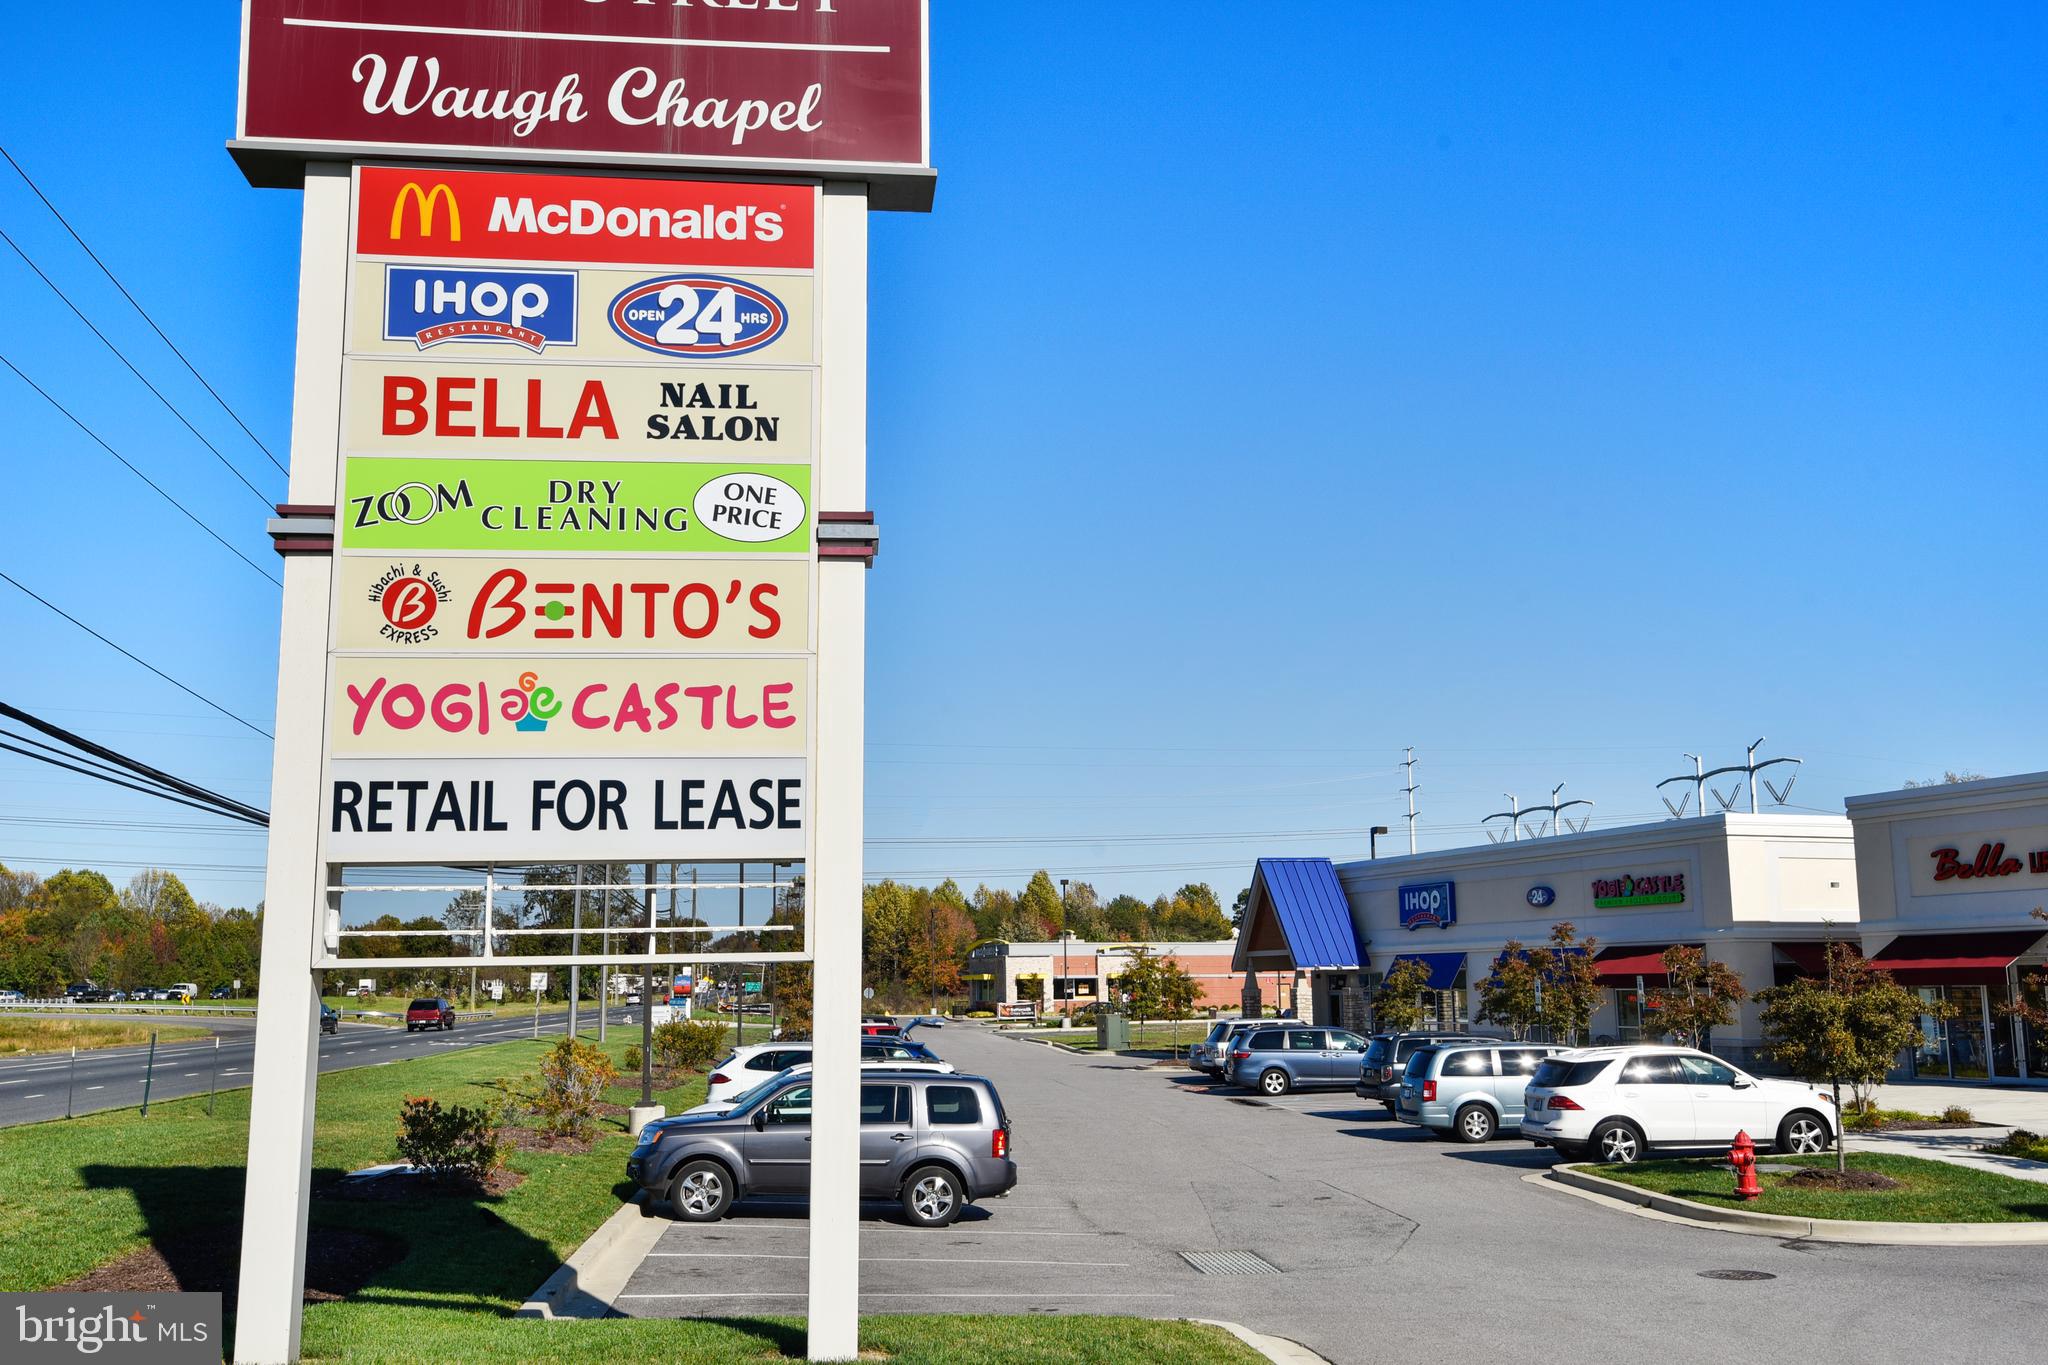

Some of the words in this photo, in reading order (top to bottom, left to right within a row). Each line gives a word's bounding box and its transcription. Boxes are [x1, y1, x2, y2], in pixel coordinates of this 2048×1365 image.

[351, 53, 589, 137] Waugh
[607, 66, 823, 146] Chapel
[487, 196, 784, 242] McDonald's
[414, 278, 549, 328] IHOP
[628, 309, 665, 321] OPEN
[655, 284, 743, 346] 24
[740, 312, 769, 324] HRS
[425, 323, 537, 343] RESTAURANT
[381, 375, 620, 439] BELLA
[660, 382, 758, 410] NAIL
[646, 414, 780, 442] SALON
[351, 479, 474, 529] ZOOM
[548, 479, 623, 505] DRY
[723, 481, 778, 506] ONE
[480, 505, 688, 532] CLEANING
[711, 503, 783, 530] PRICE
[368, 562, 405, 602] Hibachi
[412, 563, 422, 577] &
[427, 571, 452, 603] Sushi
[466, 568, 782, 639] BENTO'S
[379, 623, 439, 645] EXPRESS
[346, 677, 490, 735] YOGI
[571, 681, 797, 733] CASTLE
[331, 780, 508, 832] RETAIL
[531, 778, 629, 831] FOR
[654, 778, 801, 830] LEASE
[1930, 842, 2024, 881] Bella
[1404, 889, 1441, 915] IHOP
[1531, 889, 1543, 904] 24
[1592, 879, 1622, 899] YOGI
[1635, 873, 1685, 894] CASTLE
